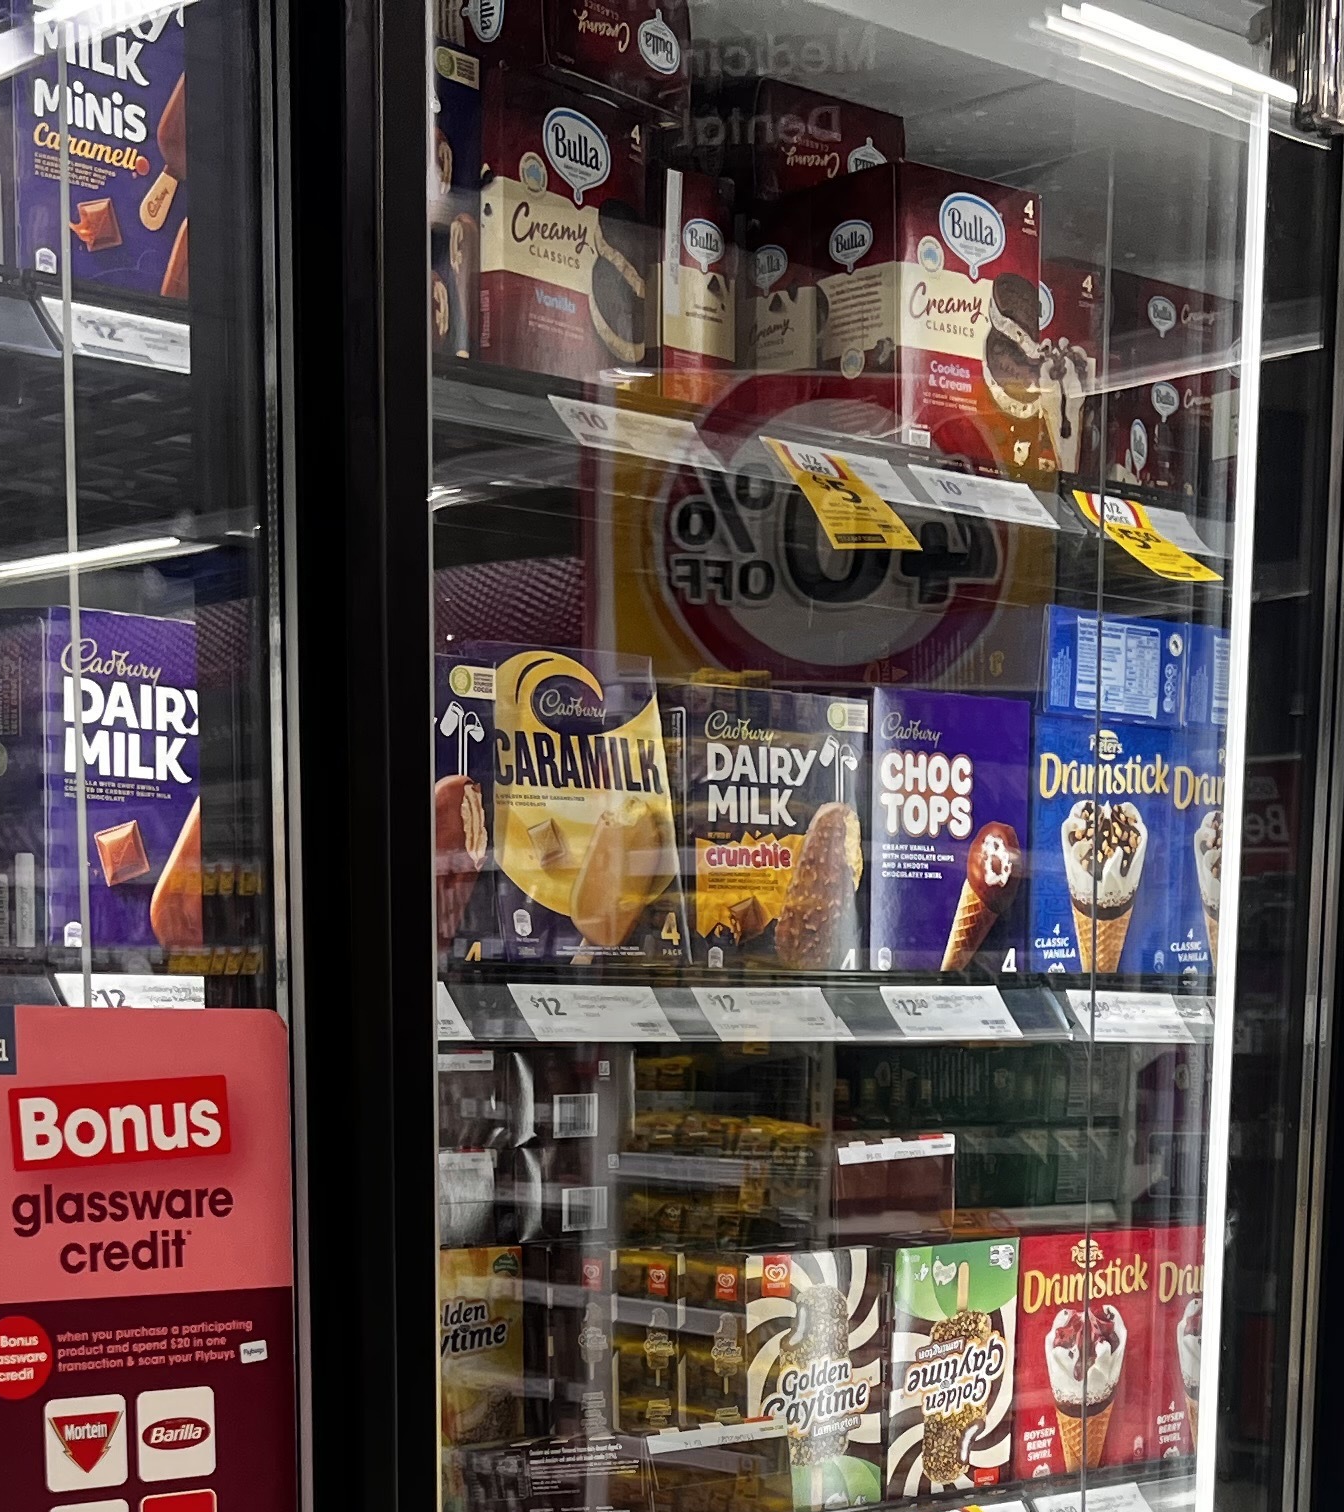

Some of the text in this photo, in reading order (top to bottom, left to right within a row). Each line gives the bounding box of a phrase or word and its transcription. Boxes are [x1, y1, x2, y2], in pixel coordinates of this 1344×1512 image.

[947, 208, 997, 246] Bulla
[909, 282, 983, 321] Creamy
[925, 319, 975, 338] CLASSICS
[60, 637, 162, 686] Cadbury
[538, 688, 609, 726] Cadbury
[705, 710, 775, 745] Cadbury
[63, 726, 193, 785] MILK
[493, 728, 664, 796] CARAMILK
[705, 742, 818, 788] DAIRY
[880, 752, 973, 795] CHOC
[1038, 752, 1171, 799] Drumstick
[706, 784, 797, 828] MILK
[881, 794, 972, 839] TOPS
[705, 841, 792, 870] crunchie
[1034, 936, 1070, 949] CLASSIC
[1042, 948, 1076, 959] VANILLA
[17, 1097, 223, 1162] Bonus
[12, 1183, 234, 1238] glassware
[1022, 1255, 1149, 1315] Drumstick
[0, 1332, 39, 1348] Bonus
[57, 1331, 89, 1344] when
[91, 1330, 114, 1345] you
[116, 1325, 169, 1342] purchase
[181, 1319, 254, 1336] participating
[57, 1335, 228, 1361] product and spend $20 in one
[57, 1356, 125, 1373] transaction
[137, 1355, 167, 1367] scan
[169, 1352, 194, 1366] your
[195, 1348, 237, 1365] Flybuys
[781, 1358, 850, 1395] Golden
[762, 1378, 867, 1426] Gaytime
[63, 1421, 109, 1443] Mortein
[150, 1424, 206, 1444] Barilla
[812, 1414, 860, 1437] Lamington
